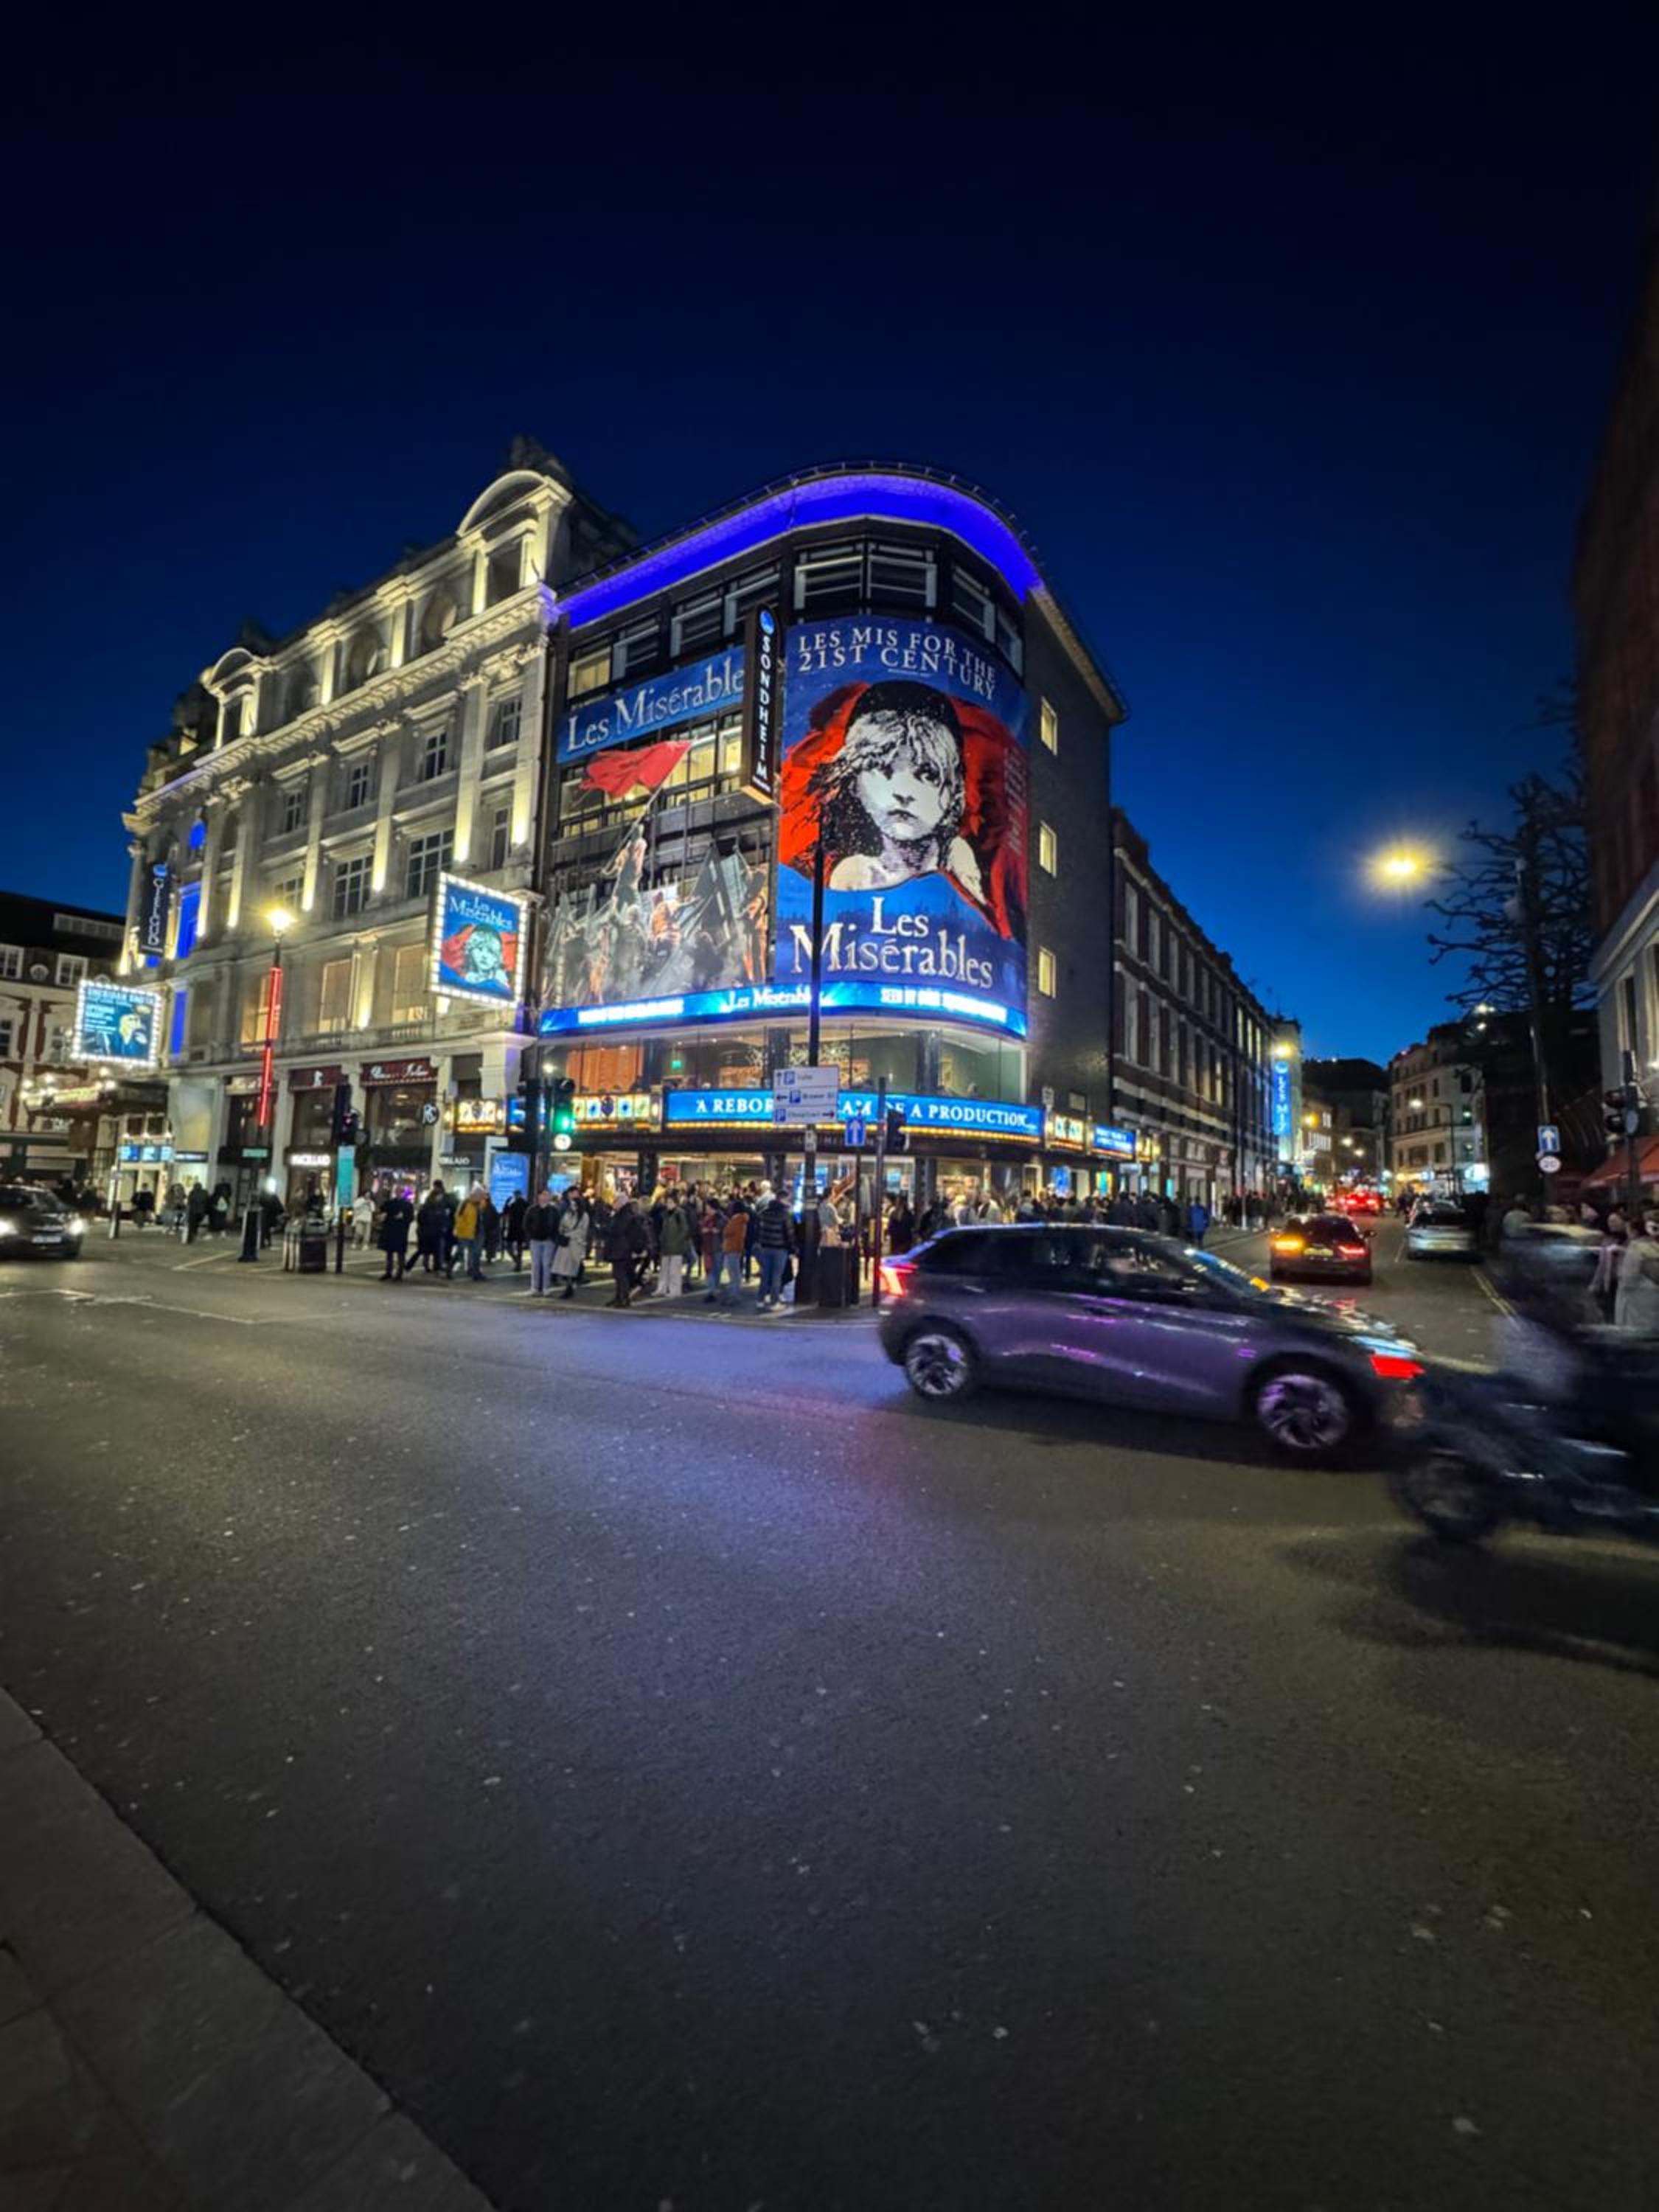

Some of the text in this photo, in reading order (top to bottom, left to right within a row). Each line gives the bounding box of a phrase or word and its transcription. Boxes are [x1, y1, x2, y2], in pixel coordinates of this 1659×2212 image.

[799, 627, 996, 684] LES MIS FOR THE
[799, 644, 995, 700] 21ST CENTURY
[567, 656, 745, 751] Les Misérable
[756, 636, 772, 780] SONDHEIM
[474, 896, 490, 912] Les
[871, 896, 930, 938] Les
[789, 922, 993, 989] Misérables
[725, 990, 750, 1010] Les
[695, 1098, 708, 1113] A
[911, 1103, 922, 1118] A
